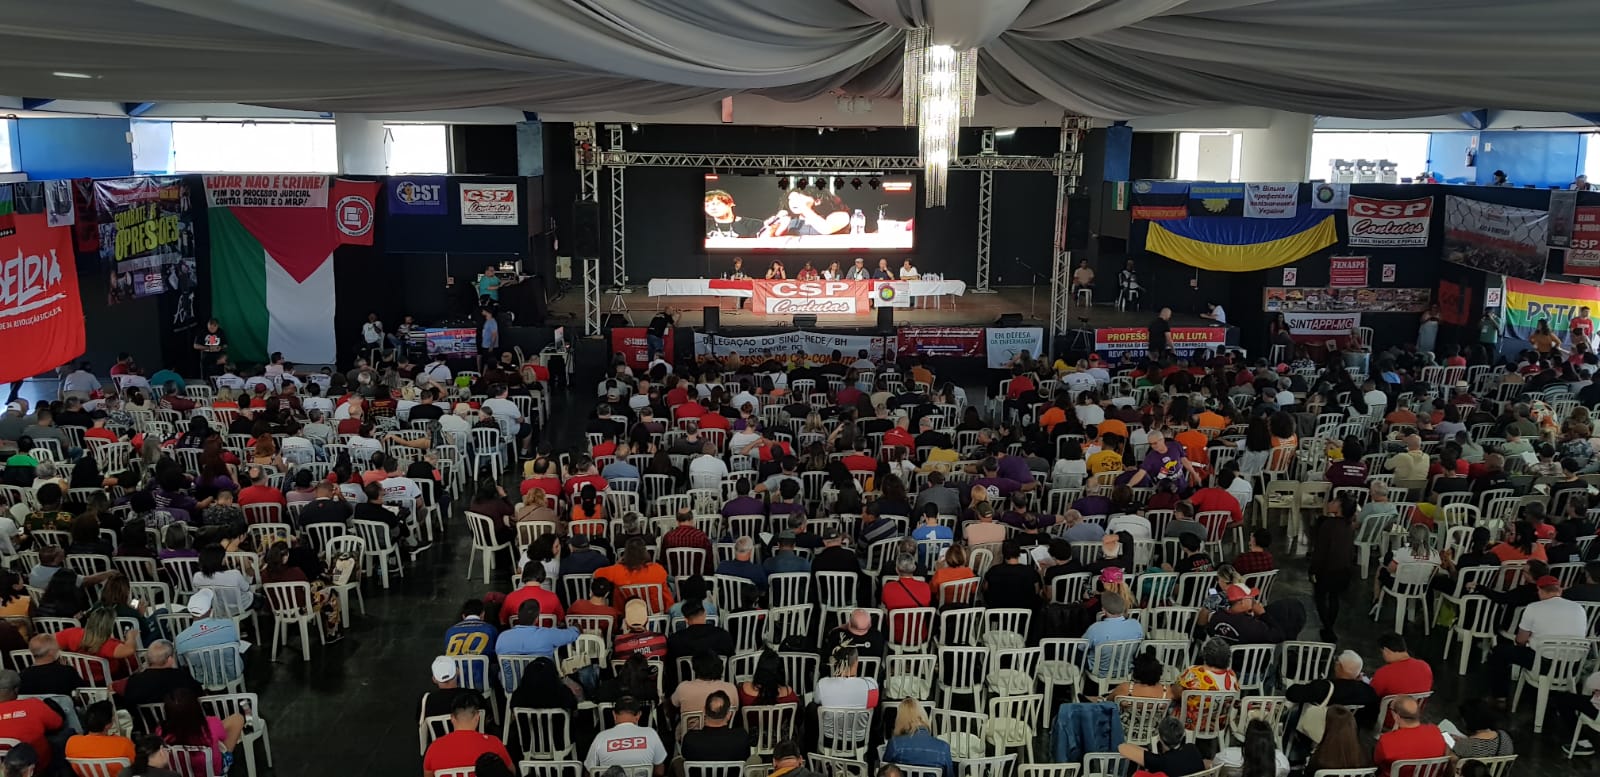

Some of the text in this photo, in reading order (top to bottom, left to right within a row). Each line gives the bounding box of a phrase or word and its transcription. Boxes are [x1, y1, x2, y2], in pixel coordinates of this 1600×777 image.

[207, 176, 242, 189] LUTAR
[282, 175, 325, 189] CRIME!
[213, 189, 311, 198] FIM DO PROCESSO JUDICIAL
[412, 184, 440, 201] CST
[467, 190, 509, 201] CSP
[1353, 202, 1427, 217] CSP
[1352, 218, 1425, 236] Conlutas
[1570, 239, 1599, 249] CSP
[772, 282, 849, 297] CSP
[773, 299, 850, 313] Conlutas
[1289, 318, 1354, 330] SINTAPPI-MG
[761, 338, 775, 346] DO
[779, 333, 848, 347] SIND-REDE/BH
[1006, 331, 1031, 339] DEFESA
[1107, 332, 1149, 341] PROFESS
[1172, 332, 1185, 340] NA
[1186, 332, 1207, 340] LUTA
[446, 632, 490, 656] 60
[608, 737, 646, 750] CSP
